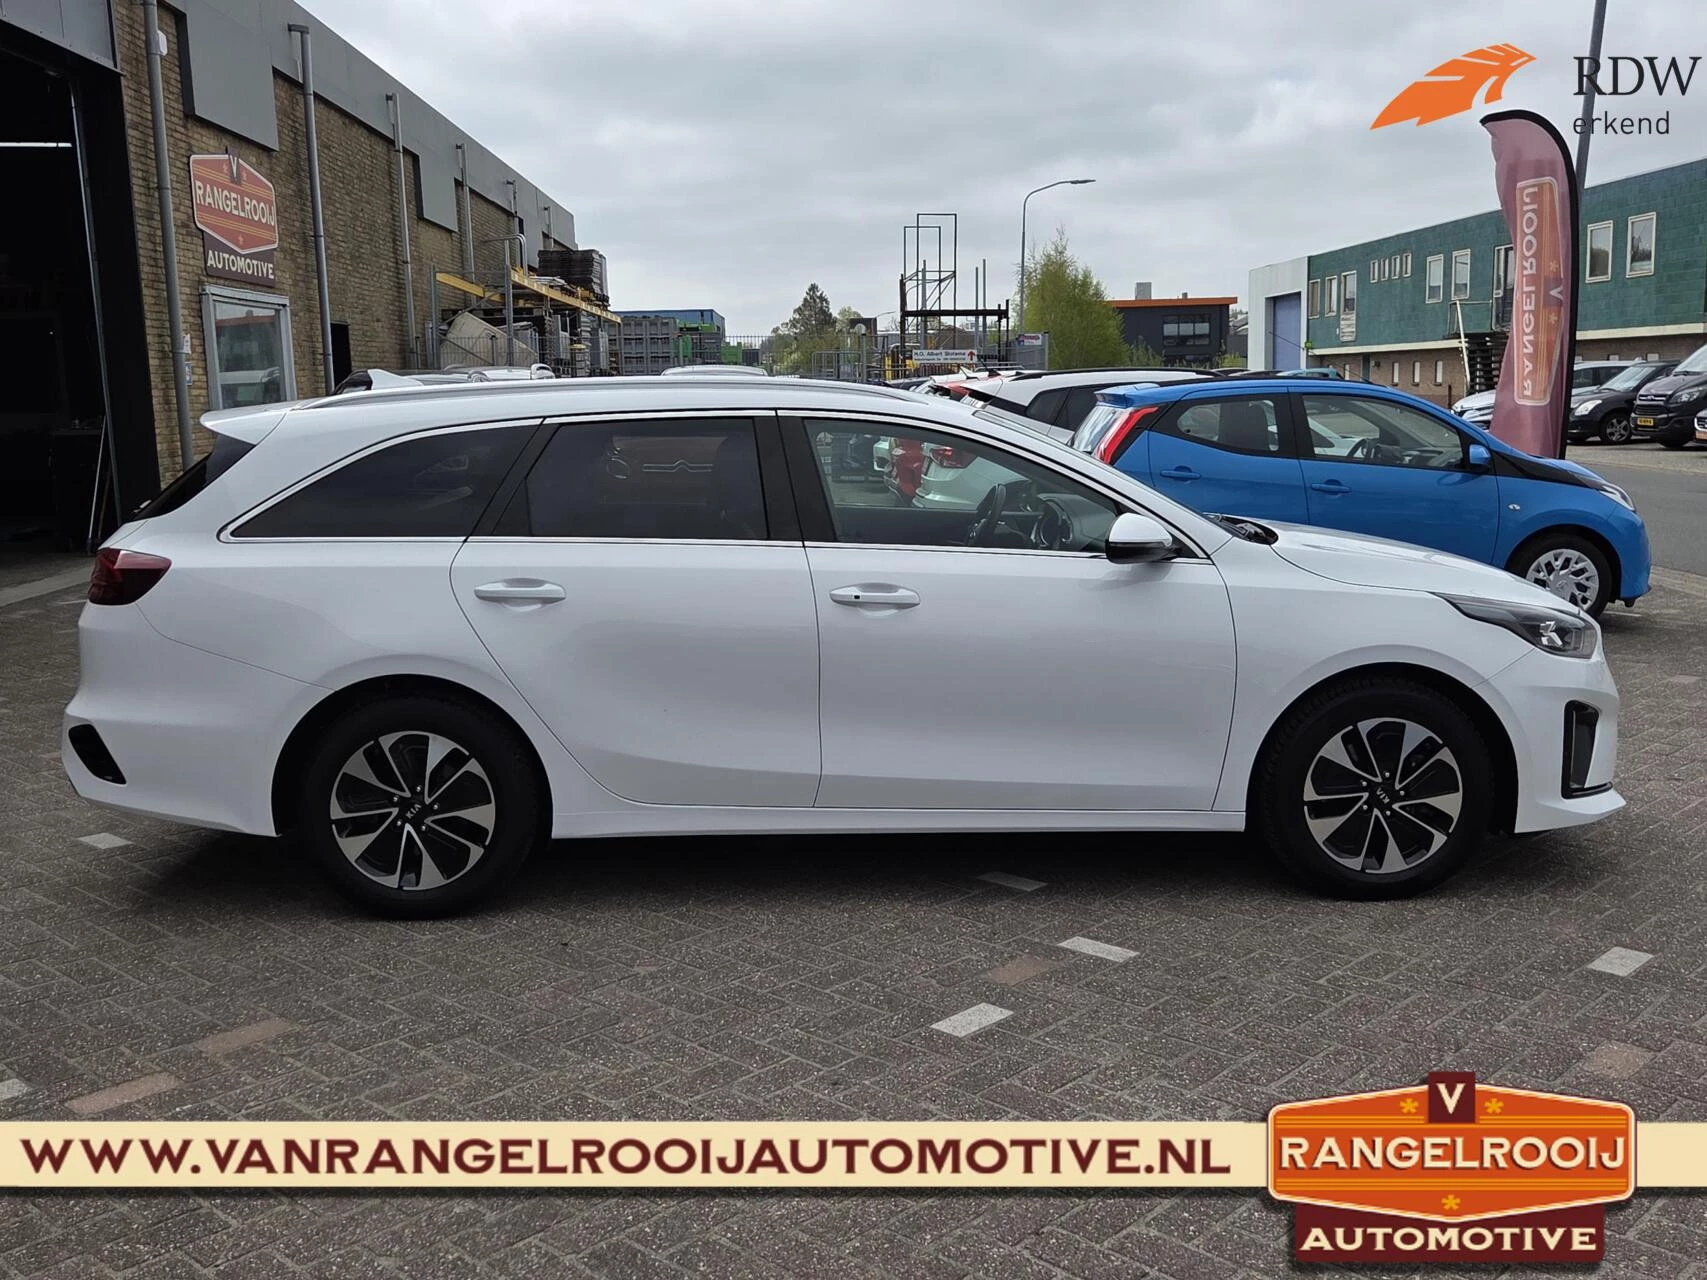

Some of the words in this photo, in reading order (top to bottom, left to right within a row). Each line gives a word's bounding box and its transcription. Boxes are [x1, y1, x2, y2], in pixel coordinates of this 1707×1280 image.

[229, 155, 238, 178] V
[195, 180, 275, 226] RANGELROOIJ
[207, 249, 275, 279] AUTOMOTIVE
